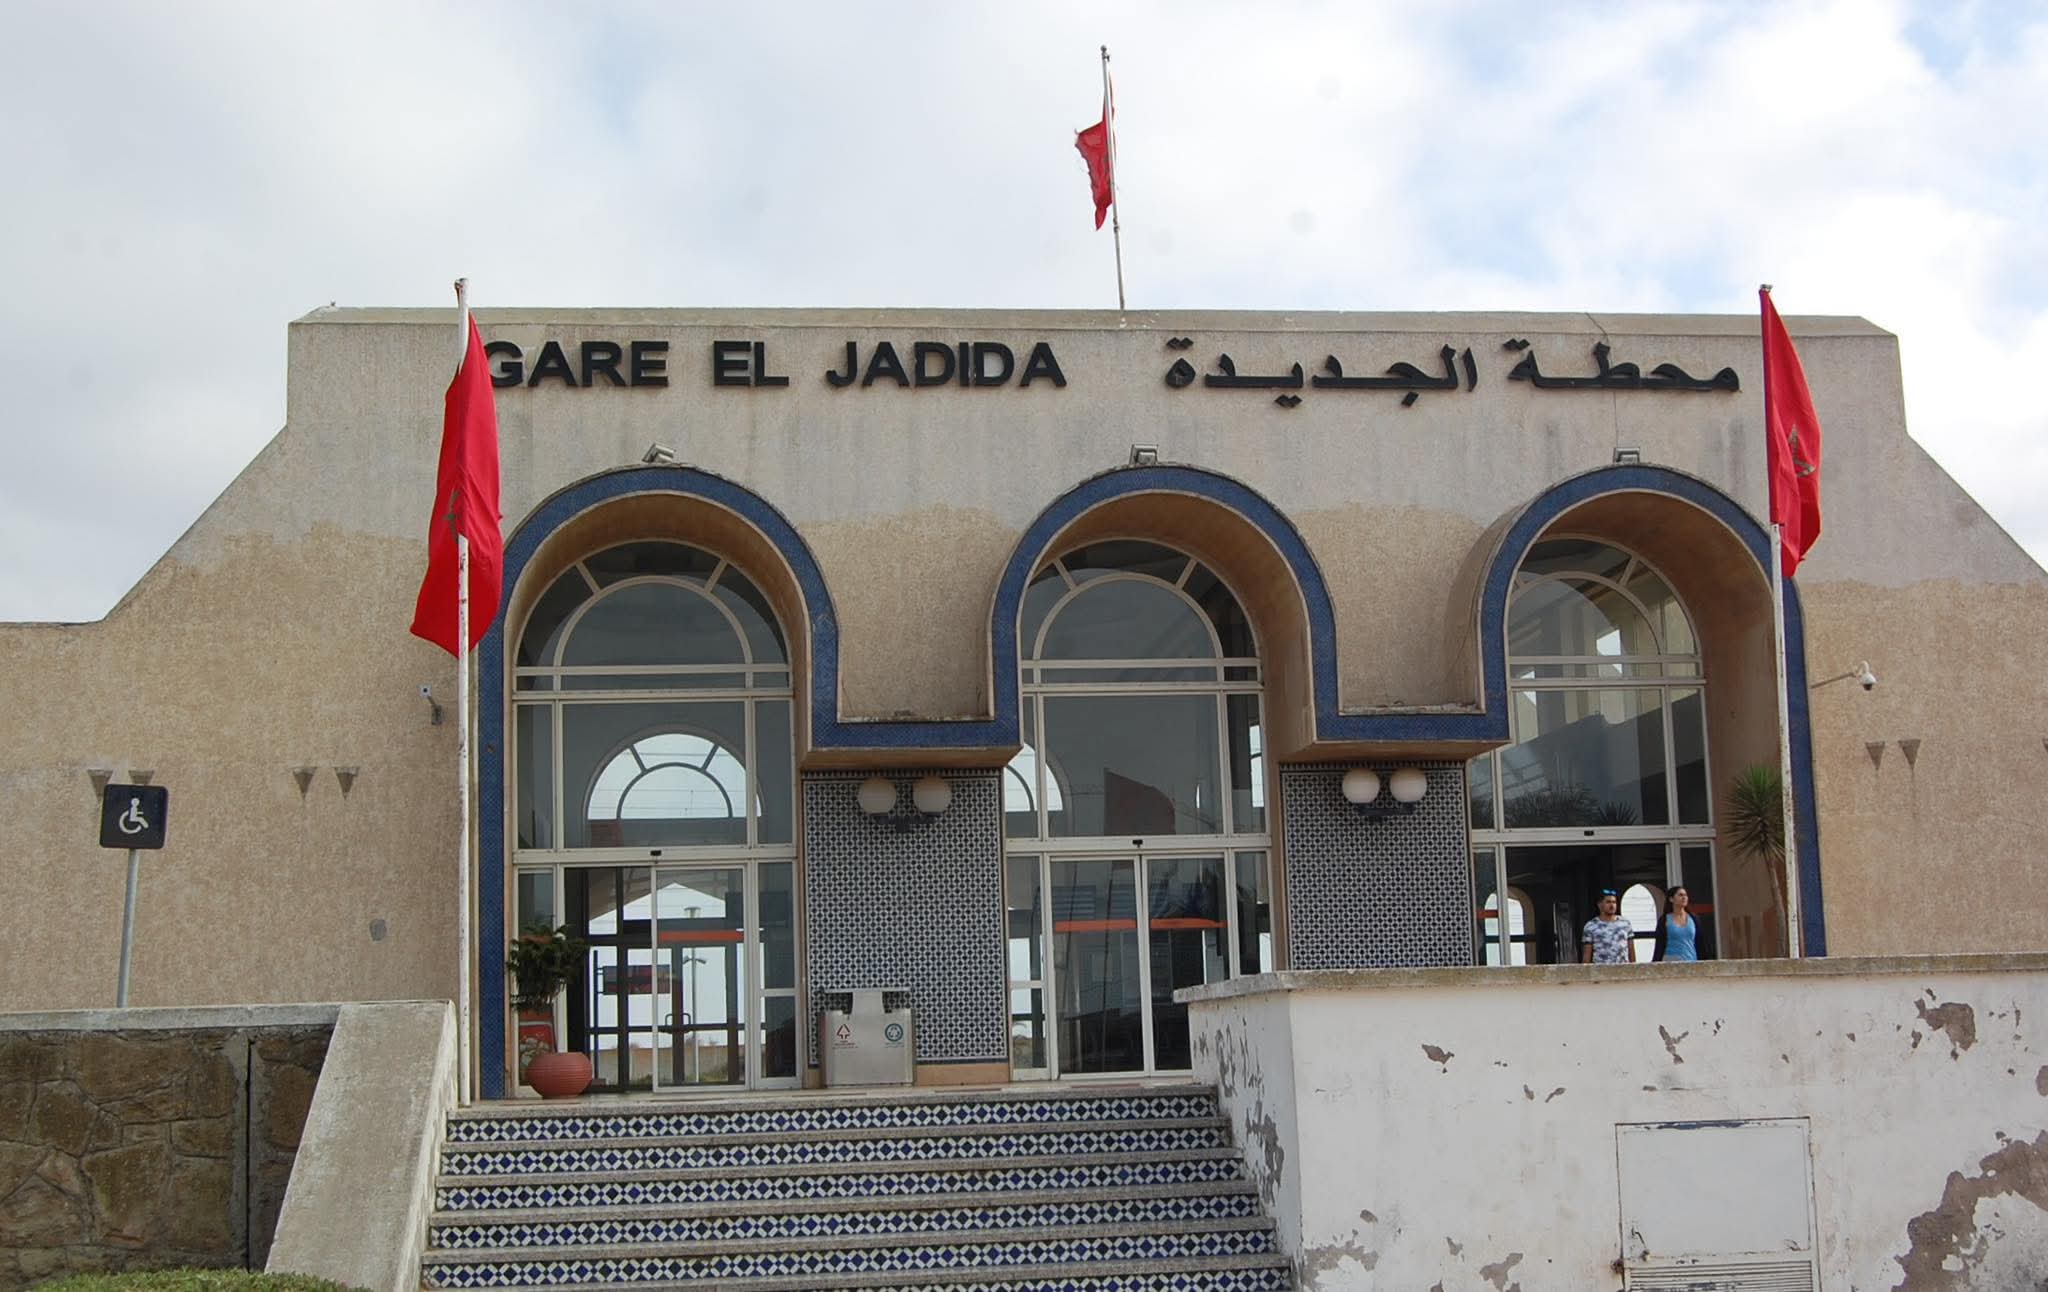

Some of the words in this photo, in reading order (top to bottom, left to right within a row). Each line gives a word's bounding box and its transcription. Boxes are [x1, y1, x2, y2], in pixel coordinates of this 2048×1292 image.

[485, 341, 669, 388] GARE
[713, 340, 789, 387] EL
[826, 341, 1068, 388] JADIDA
[1164, 336, 1478, 407] الجديدة
[1503, 337, 1740, 392] محطة
